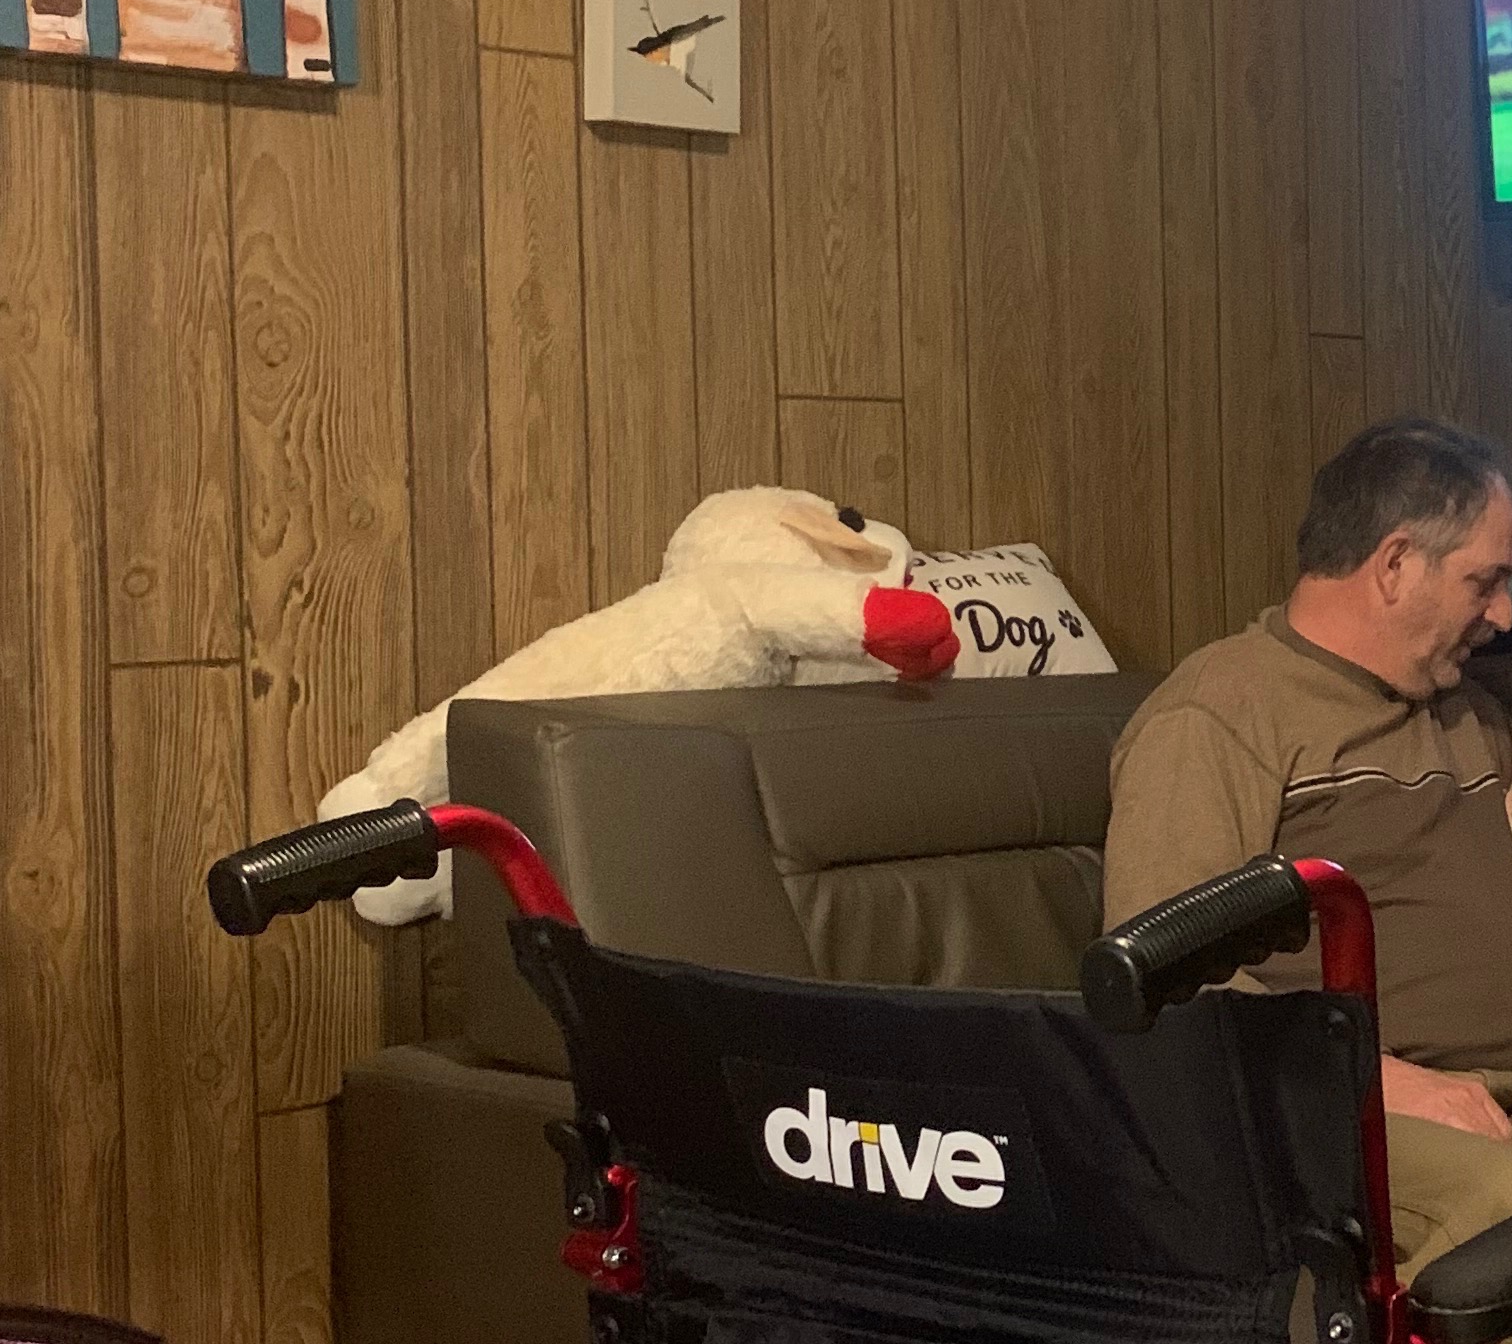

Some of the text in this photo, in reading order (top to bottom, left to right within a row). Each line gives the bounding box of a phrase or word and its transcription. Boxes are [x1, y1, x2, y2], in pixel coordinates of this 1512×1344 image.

[928, 571, 1032, 593] FOR THE
[954, 599, 1055, 676] Dog
[764, 1087, 1006, 1209] drive
